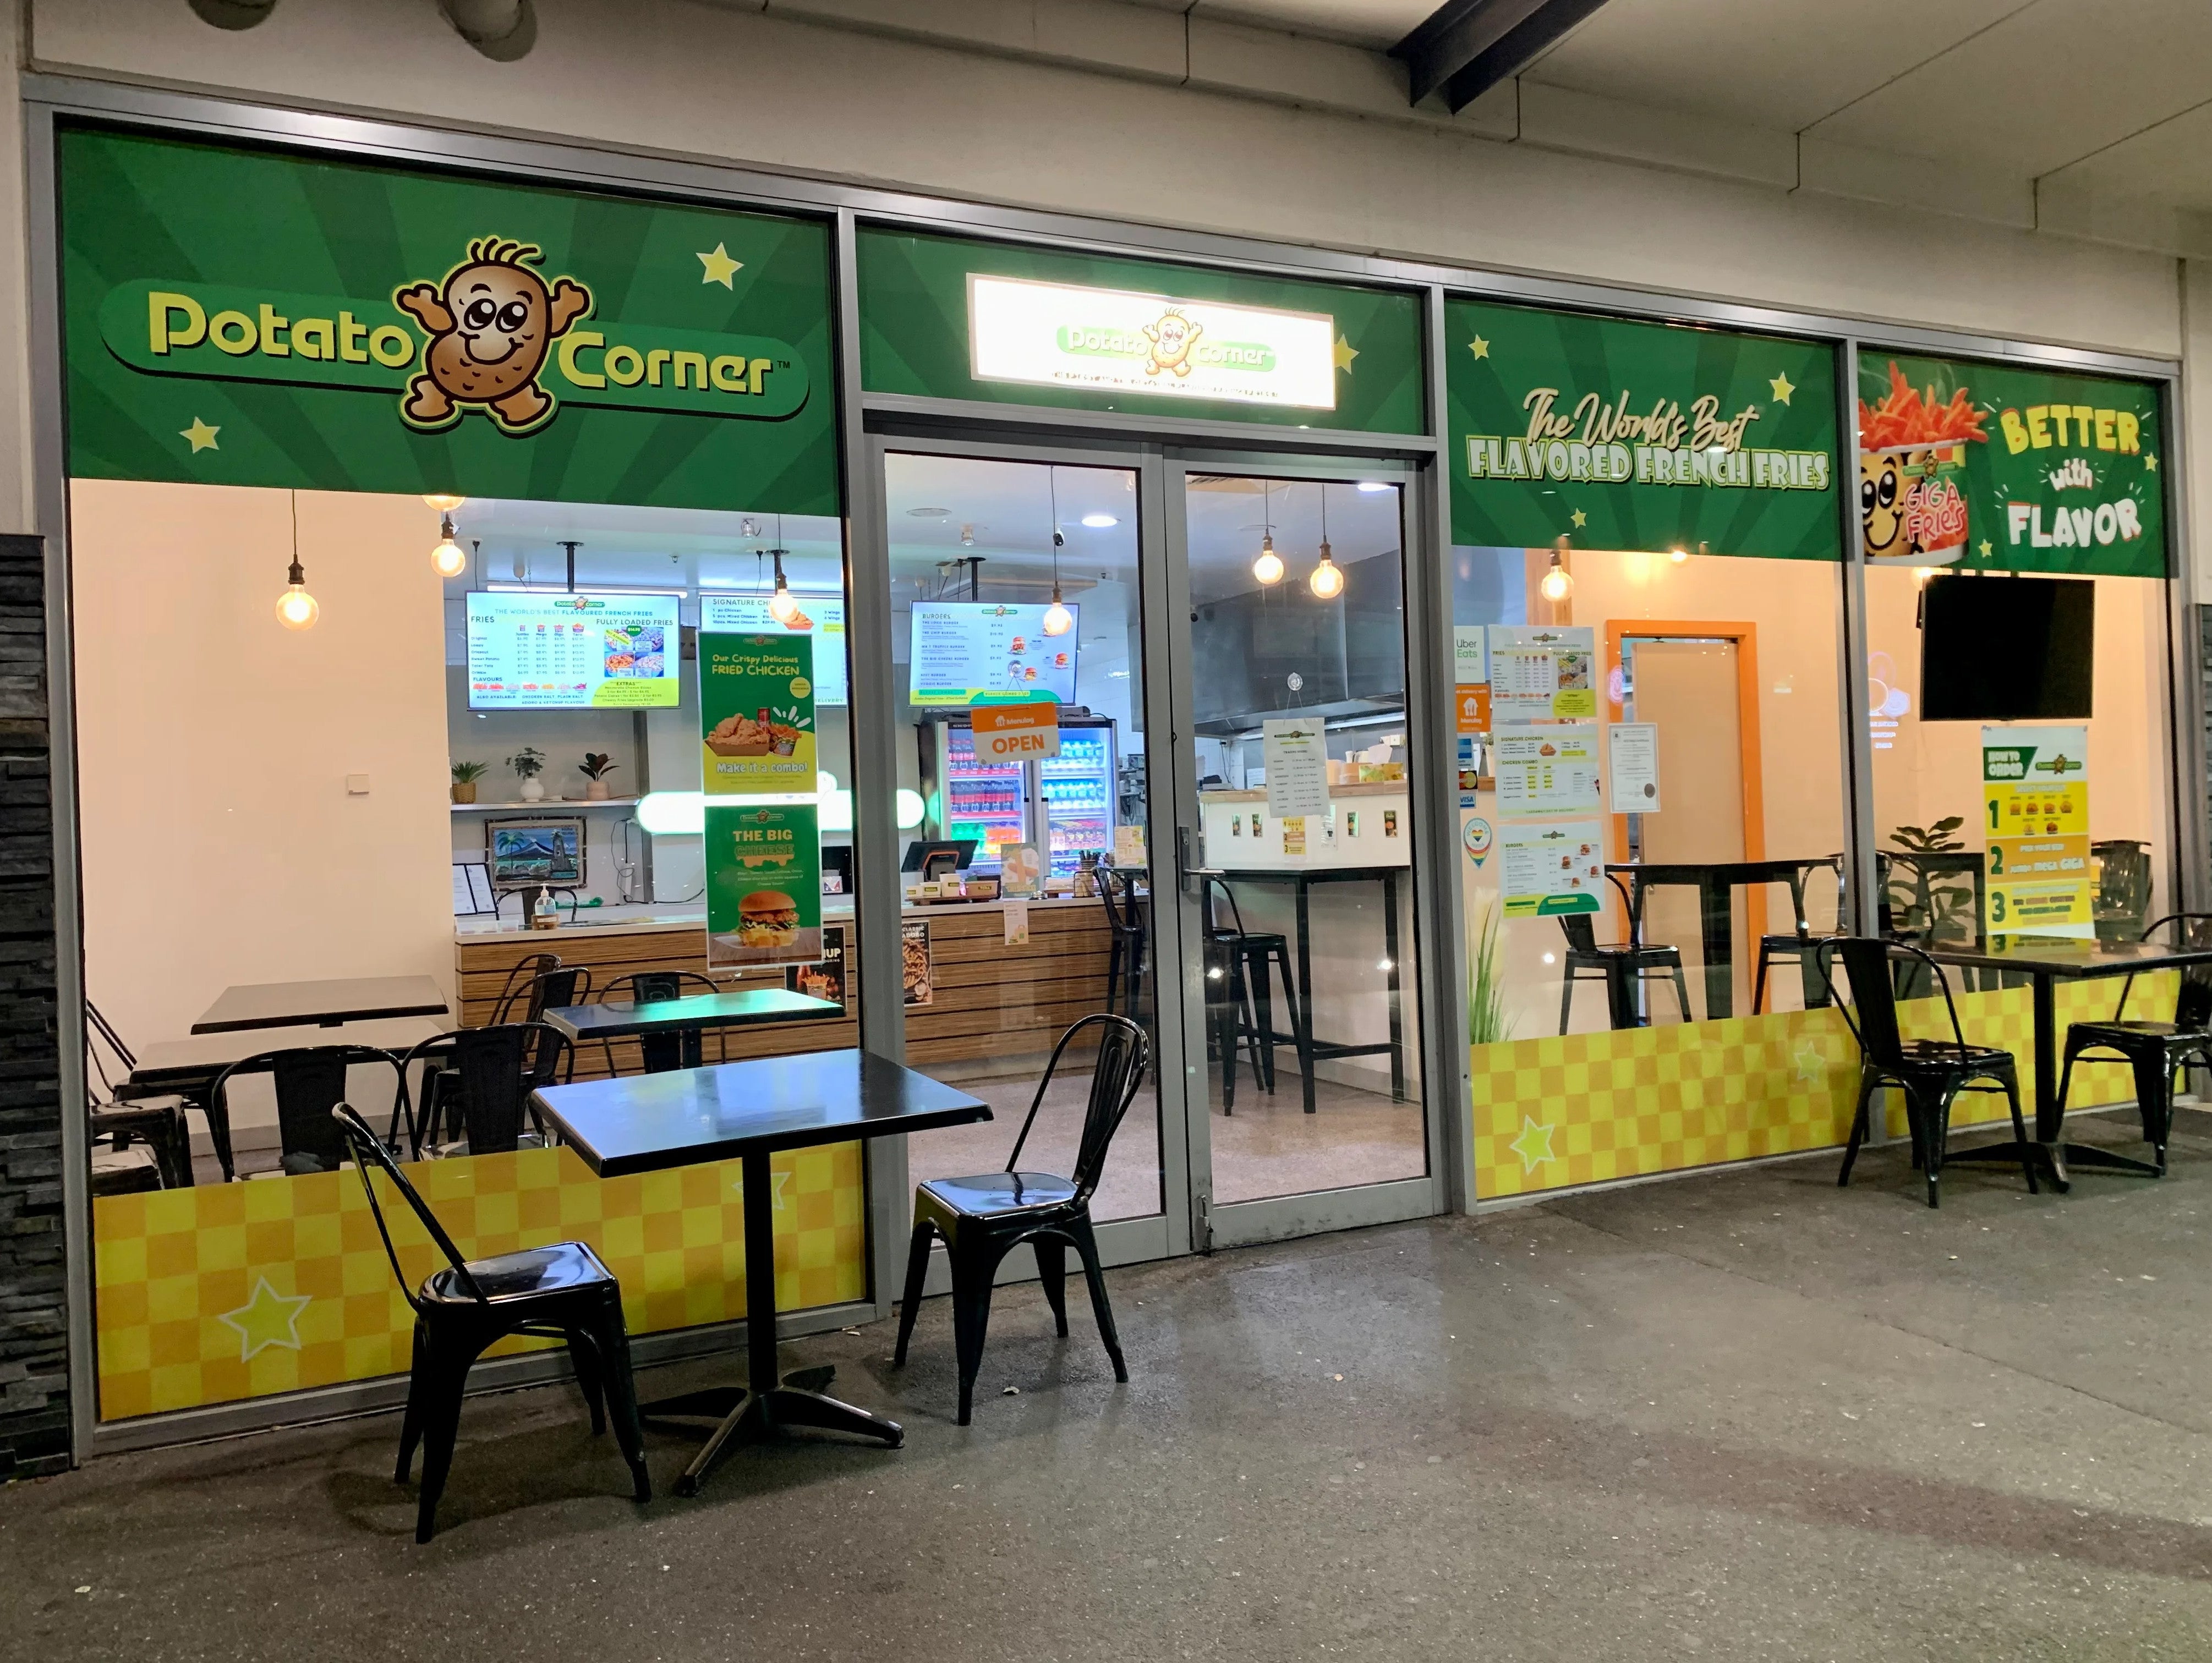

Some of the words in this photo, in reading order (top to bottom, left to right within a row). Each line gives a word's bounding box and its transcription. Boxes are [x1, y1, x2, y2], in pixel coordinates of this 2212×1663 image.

[148, 291, 415, 368] Potato
[559, 331, 774, 395] Corner
[1067, 326, 1148, 355] Potato
[1197, 345, 1267, 366] Corner
[1523, 387, 1575, 447] The
[1690, 395, 1760, 453] Best
[2000, 404, 2141, 455] BETTER
[1466, 435, 1633, 484] FLAVORED
[1634, 442, 1750, 487] FRENCH
[1751, 448, 1831, 490] FRIES
[2049, 458, 2093, 491] with
[1904, 481, 1962, 512] GIGA
[2007, 498, 2143, 548] FLAVOR
[1457, 639, 1477, 648] Uber
[1457, 649, 1478, 658] Eats
[712, 654, 729, 662] Our
[732, 654, 760, 665] Crispy
[763, 655, 798, 663] Delicious
[712, 665, 743, 675] FRIED
[747, 665, 800, 676] CHICKEN
[1006, 717, 1034, 726] Menulog
[992, 734, 1044, 754] OPEN
[716, 761, 746, 773] Make
[749, 761, 758, 773] it
[771, 761, 808, 773] combo!
[1989, 800, 1999, 828] 1
[733, 830, 763, 842] THE
[767, 830, 793, 841] BIG
[735, 844, 795, 857] CHEESE
[1990, 846, 2003, 875] 2
[1991, 891, 2006, 923] 3
